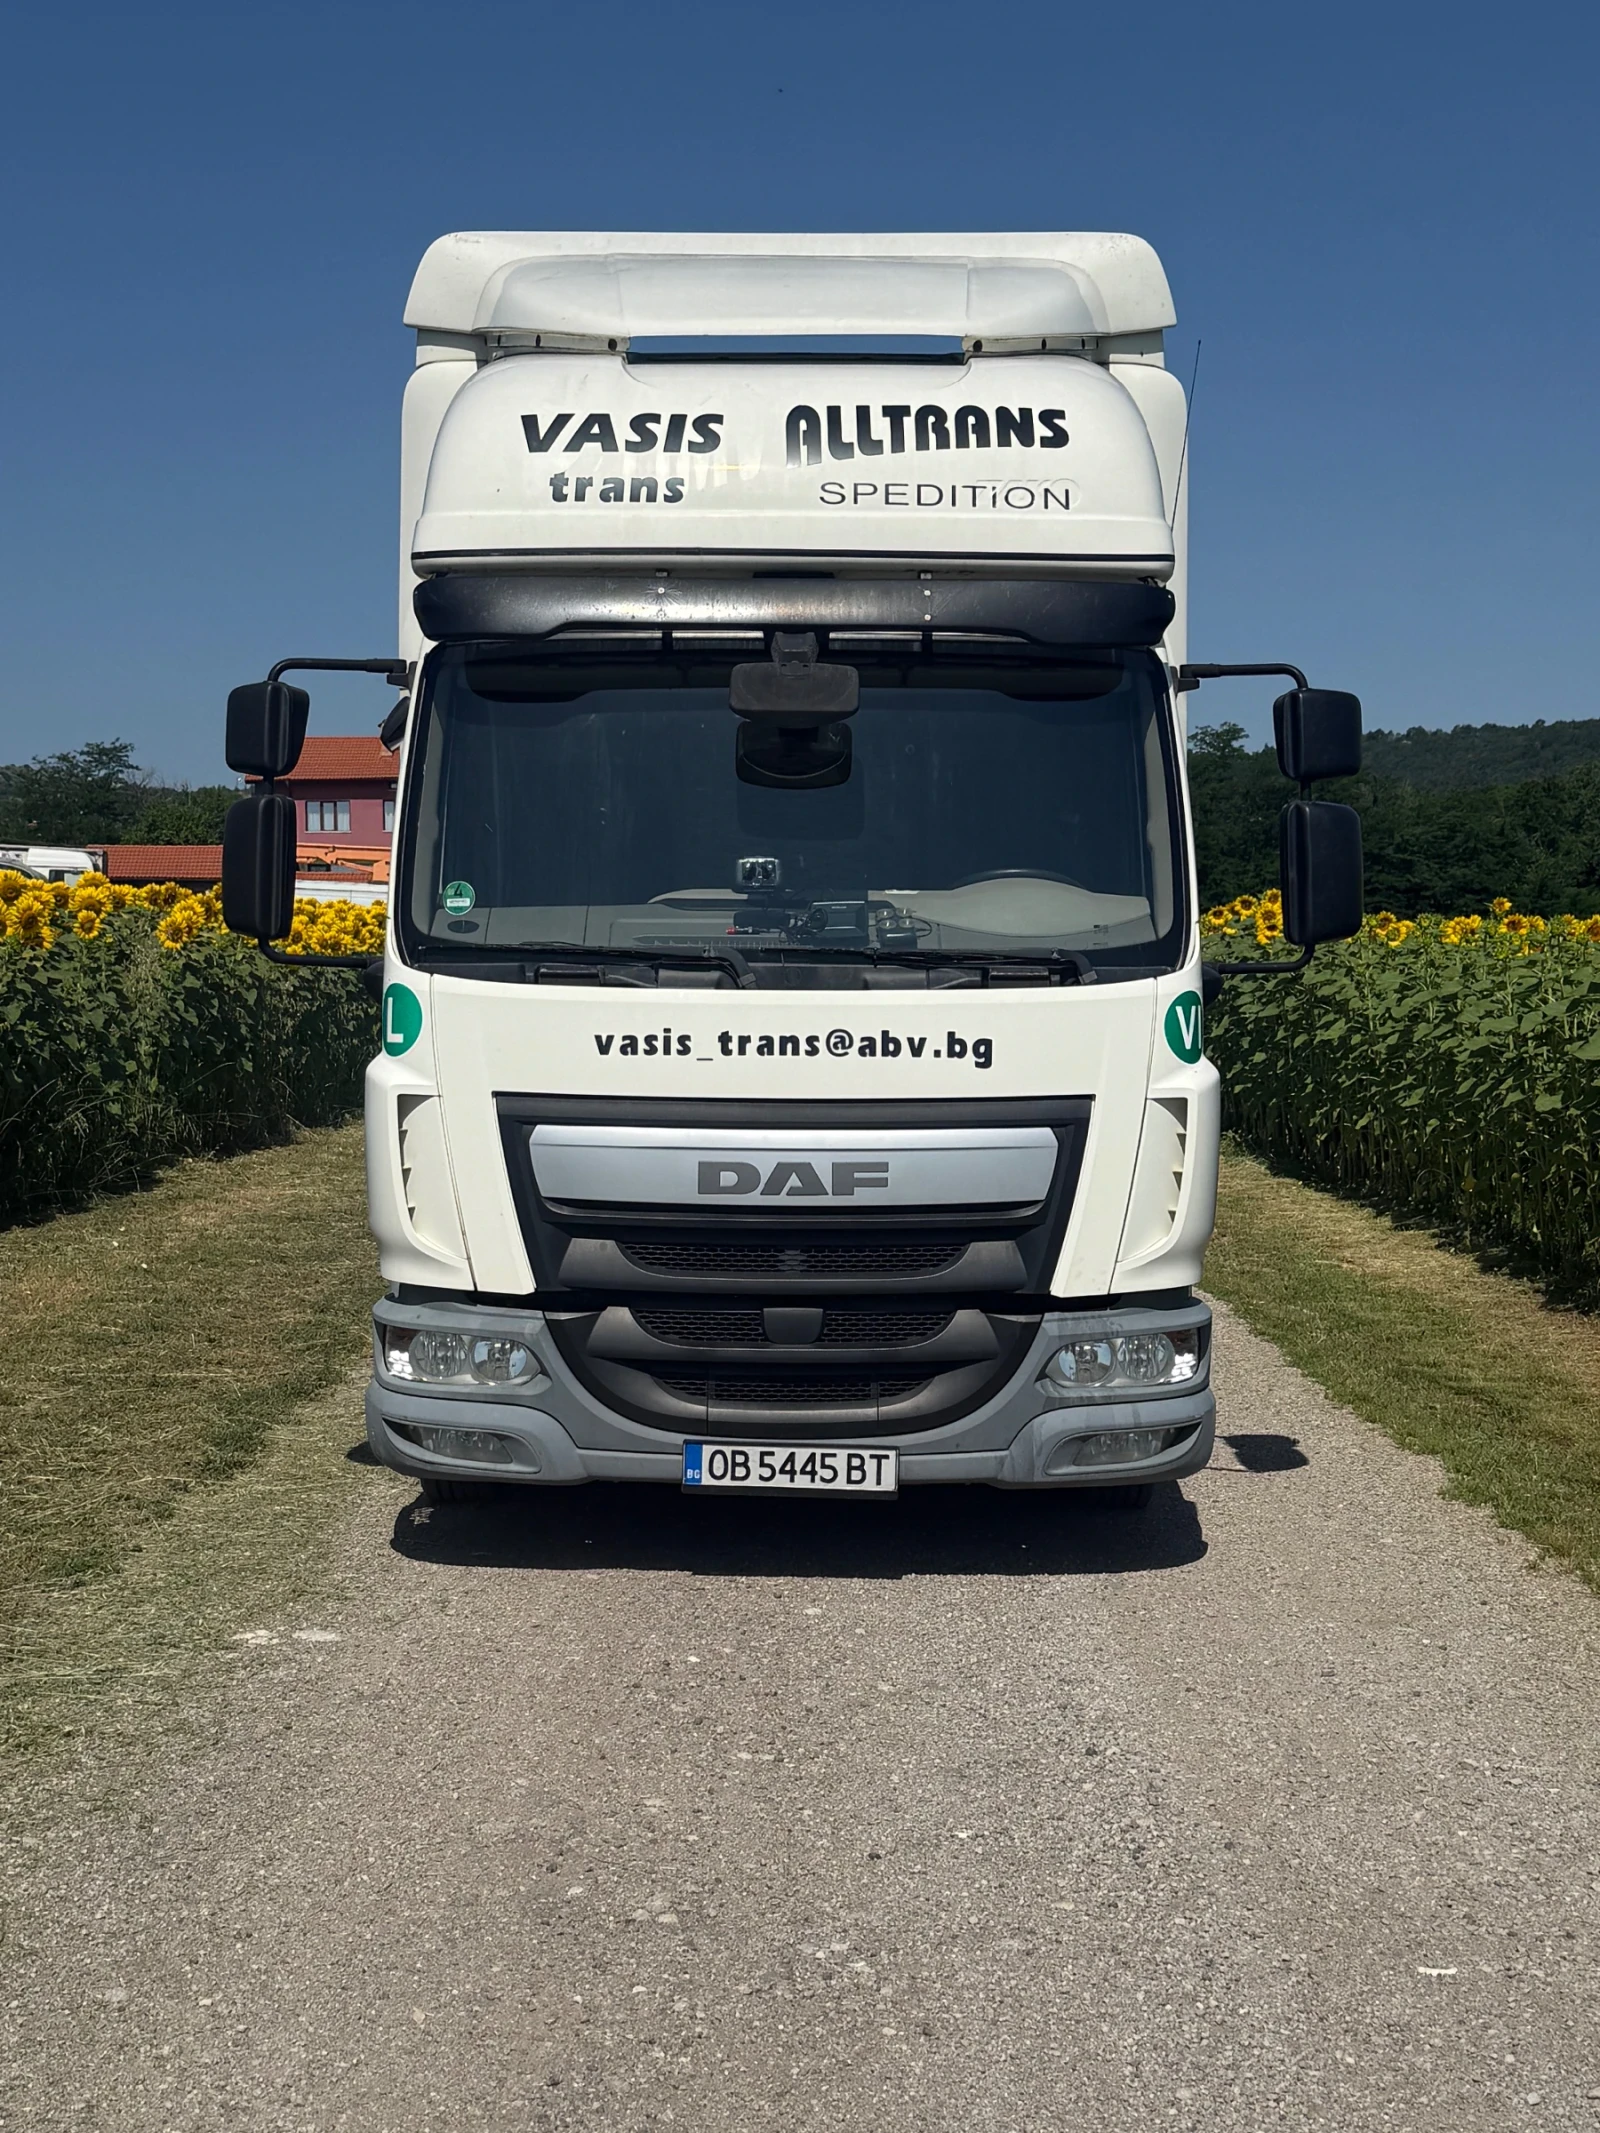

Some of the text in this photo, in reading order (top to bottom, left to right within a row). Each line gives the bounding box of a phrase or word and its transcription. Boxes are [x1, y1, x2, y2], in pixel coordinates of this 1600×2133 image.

[520, 412, 724, 454] VASIS
[785, 403, 1070, 470] ALLTRANS
[549, 471, 685, 504] trans
[386, 996, 404, 1044] L
[593, 1027, 994, 1070] vasis_trans@abv.bg
[697, 1160, 889, 1197] DAF
[686, 1469, 701, 1479] BG
